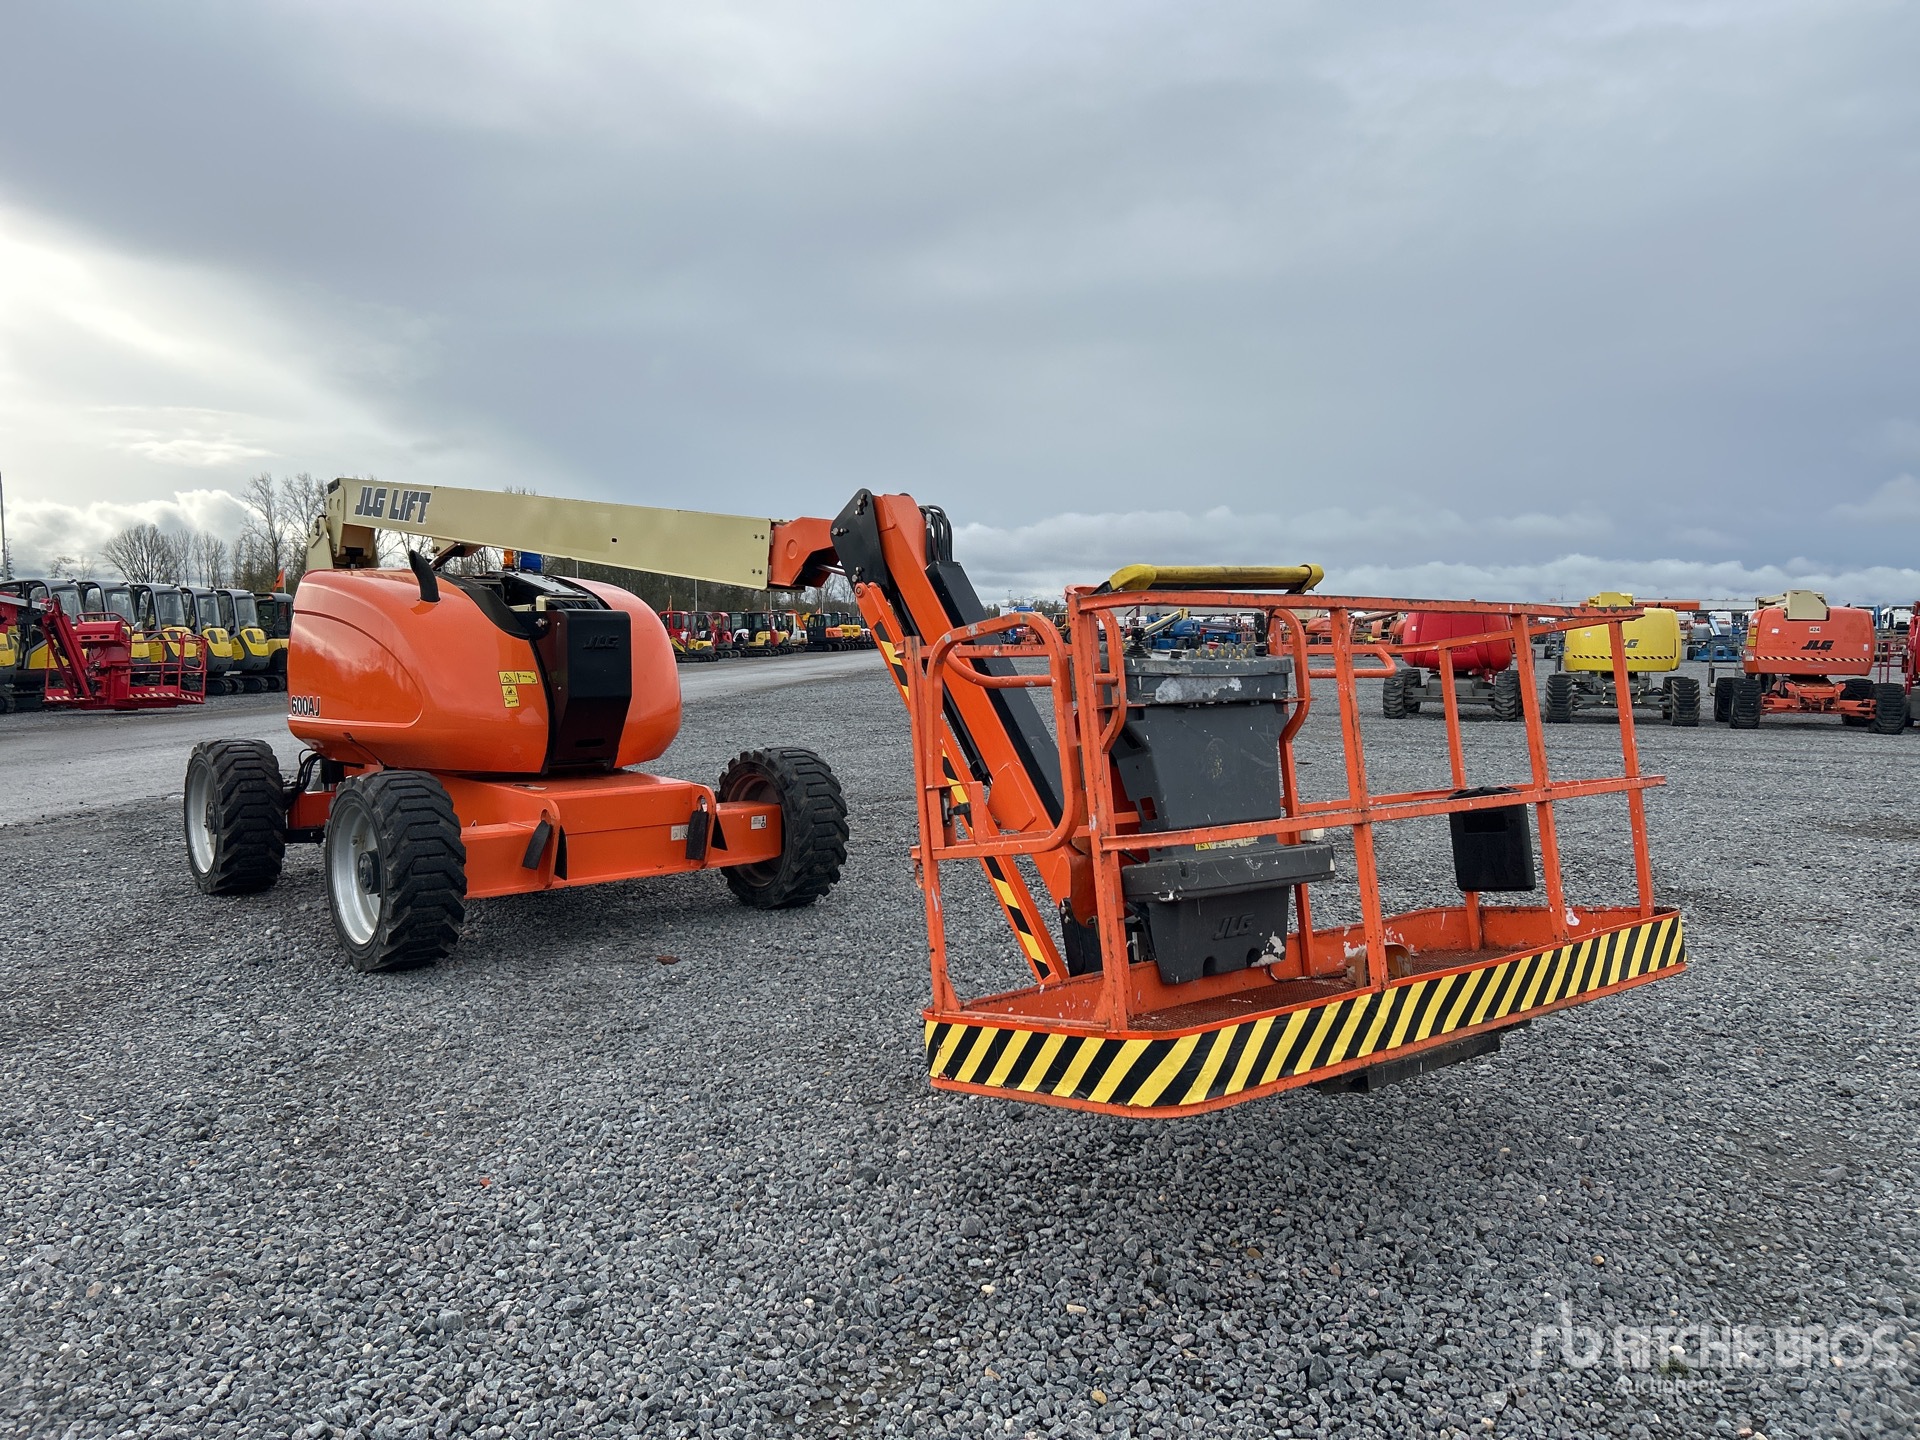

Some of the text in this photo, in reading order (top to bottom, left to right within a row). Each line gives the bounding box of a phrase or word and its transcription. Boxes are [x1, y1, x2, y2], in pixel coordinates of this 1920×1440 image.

[354, 486, 432, 525] JLG LIFT
[1801, 640, 1834, 650] JLG
[291, 695, 321, 717] 600AJ
[1213, 913, 1255, 941] JLG
